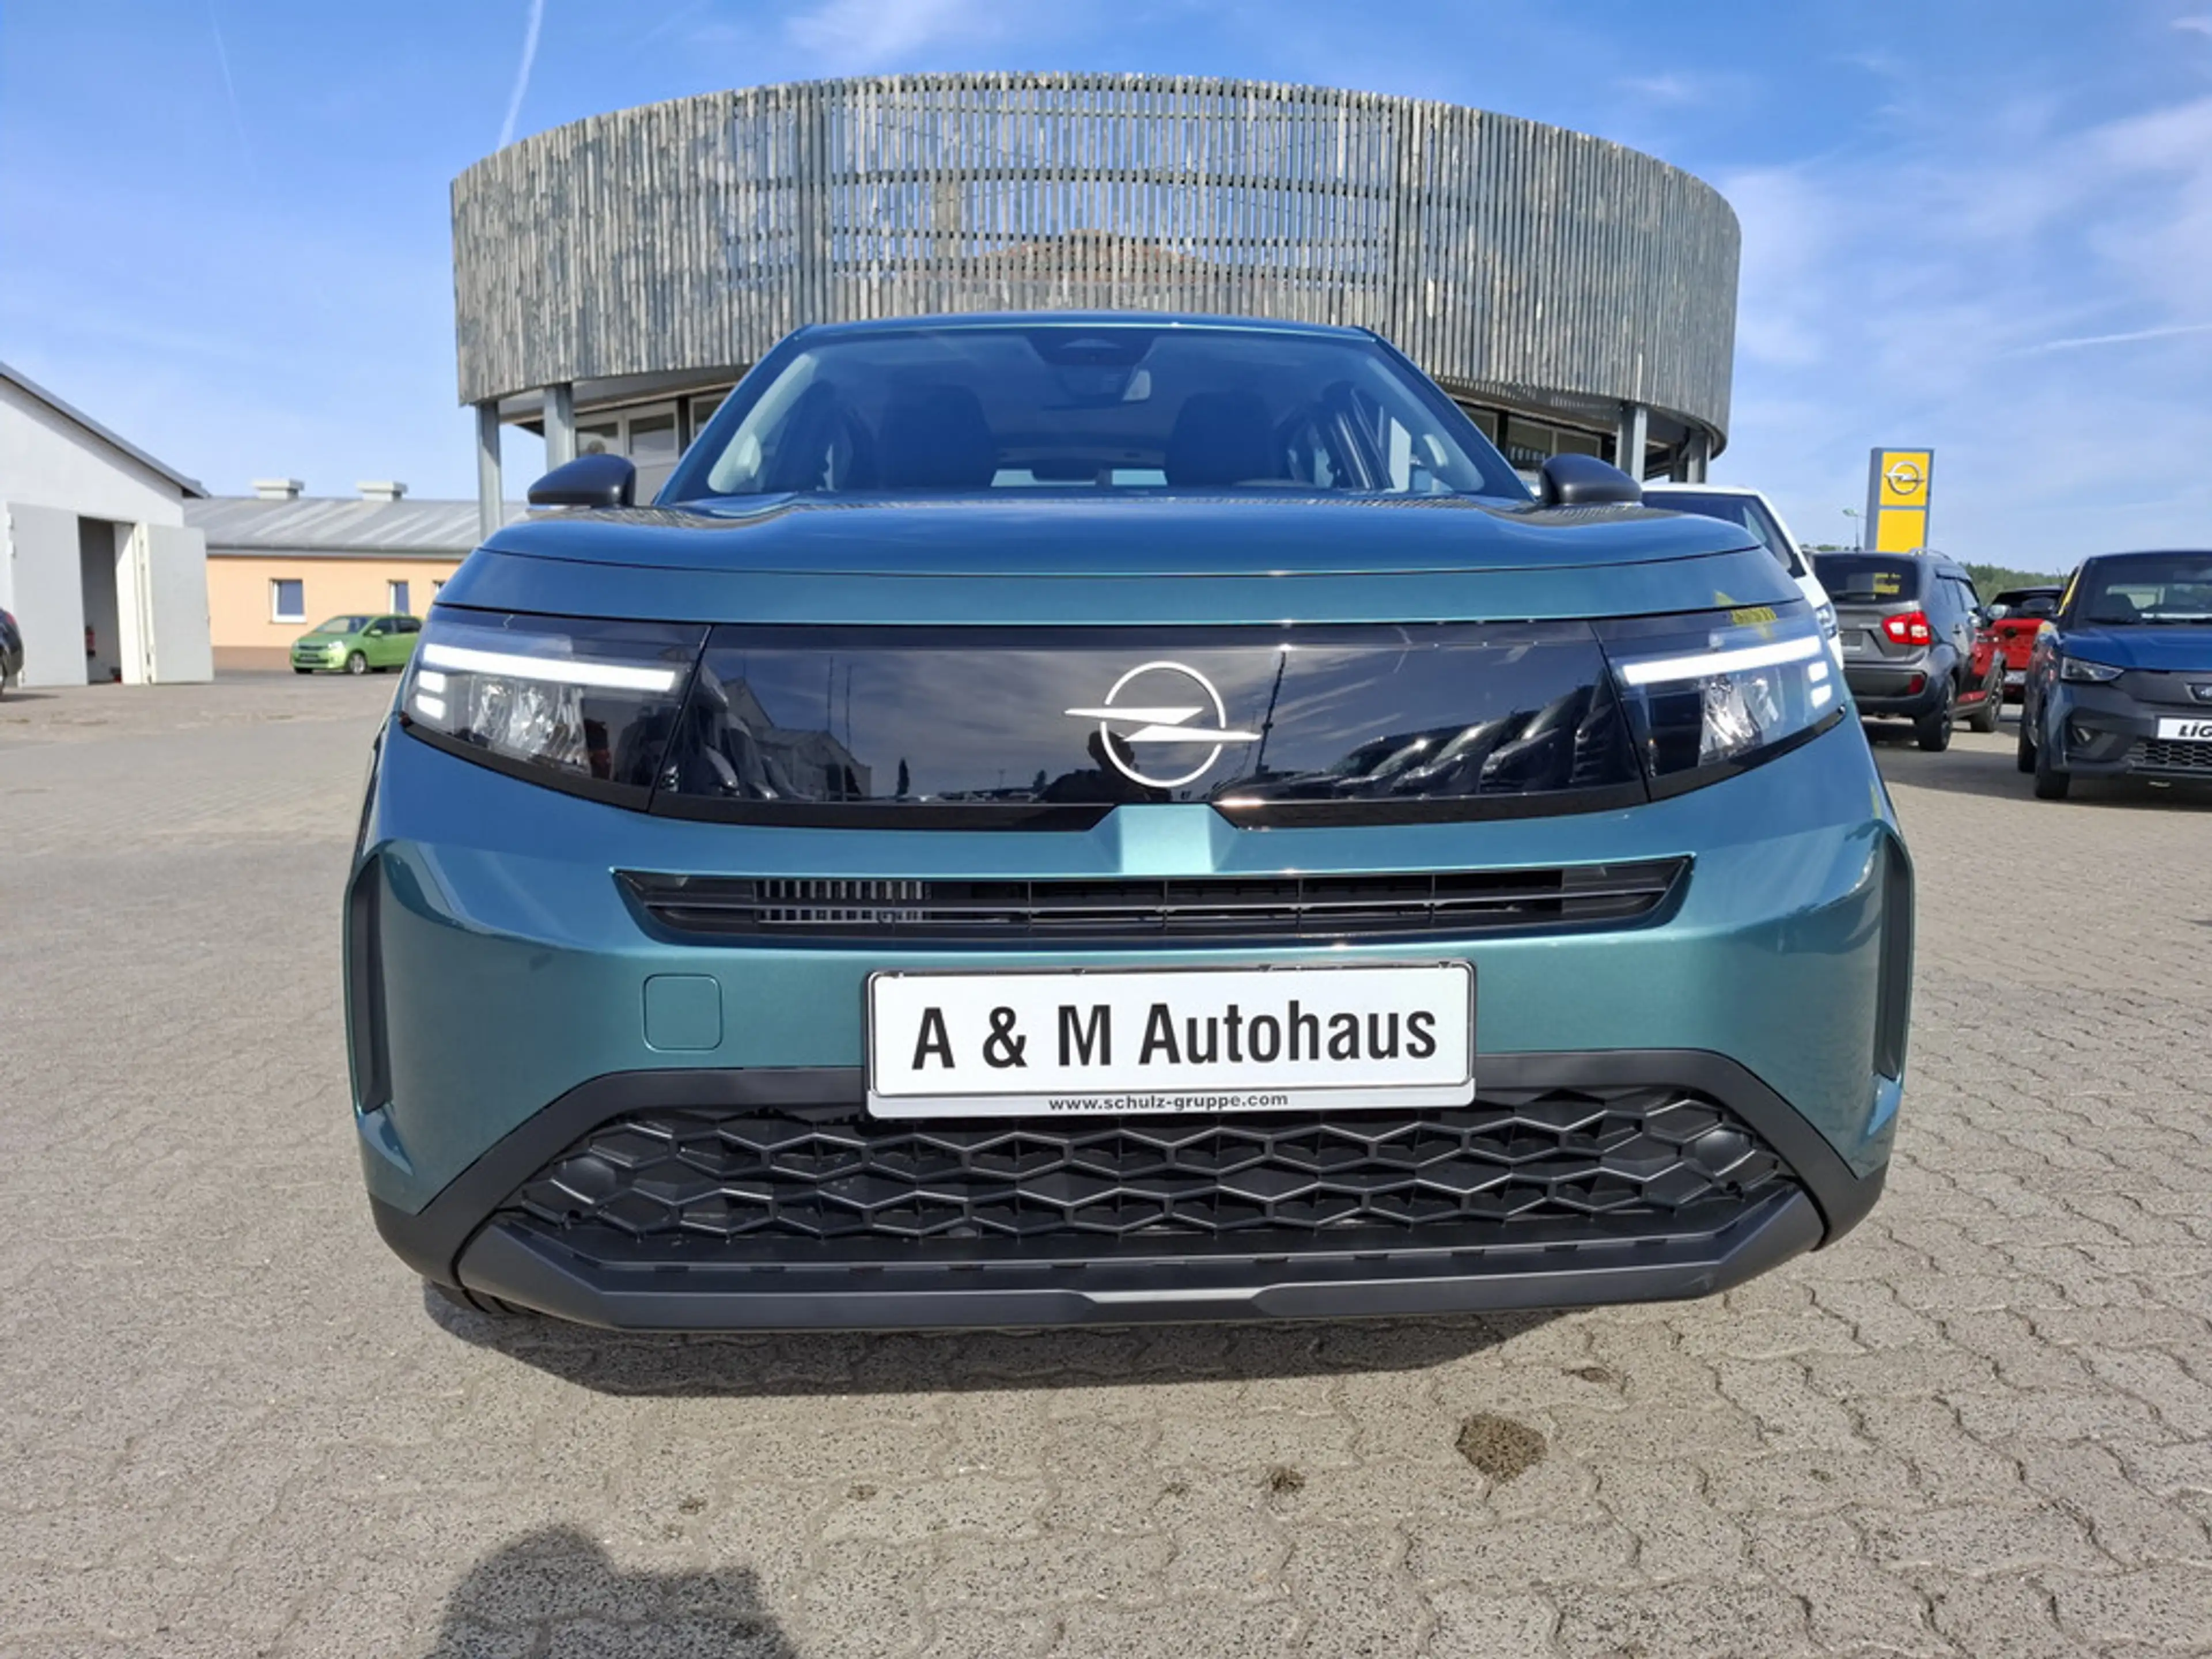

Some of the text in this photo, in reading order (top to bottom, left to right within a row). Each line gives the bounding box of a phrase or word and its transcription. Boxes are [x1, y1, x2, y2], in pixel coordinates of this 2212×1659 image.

[912, 1000, 1436, 1070] A & M Autohaus
[1049, 1095, 1288, 1111] www.schulz-gruppe.com
